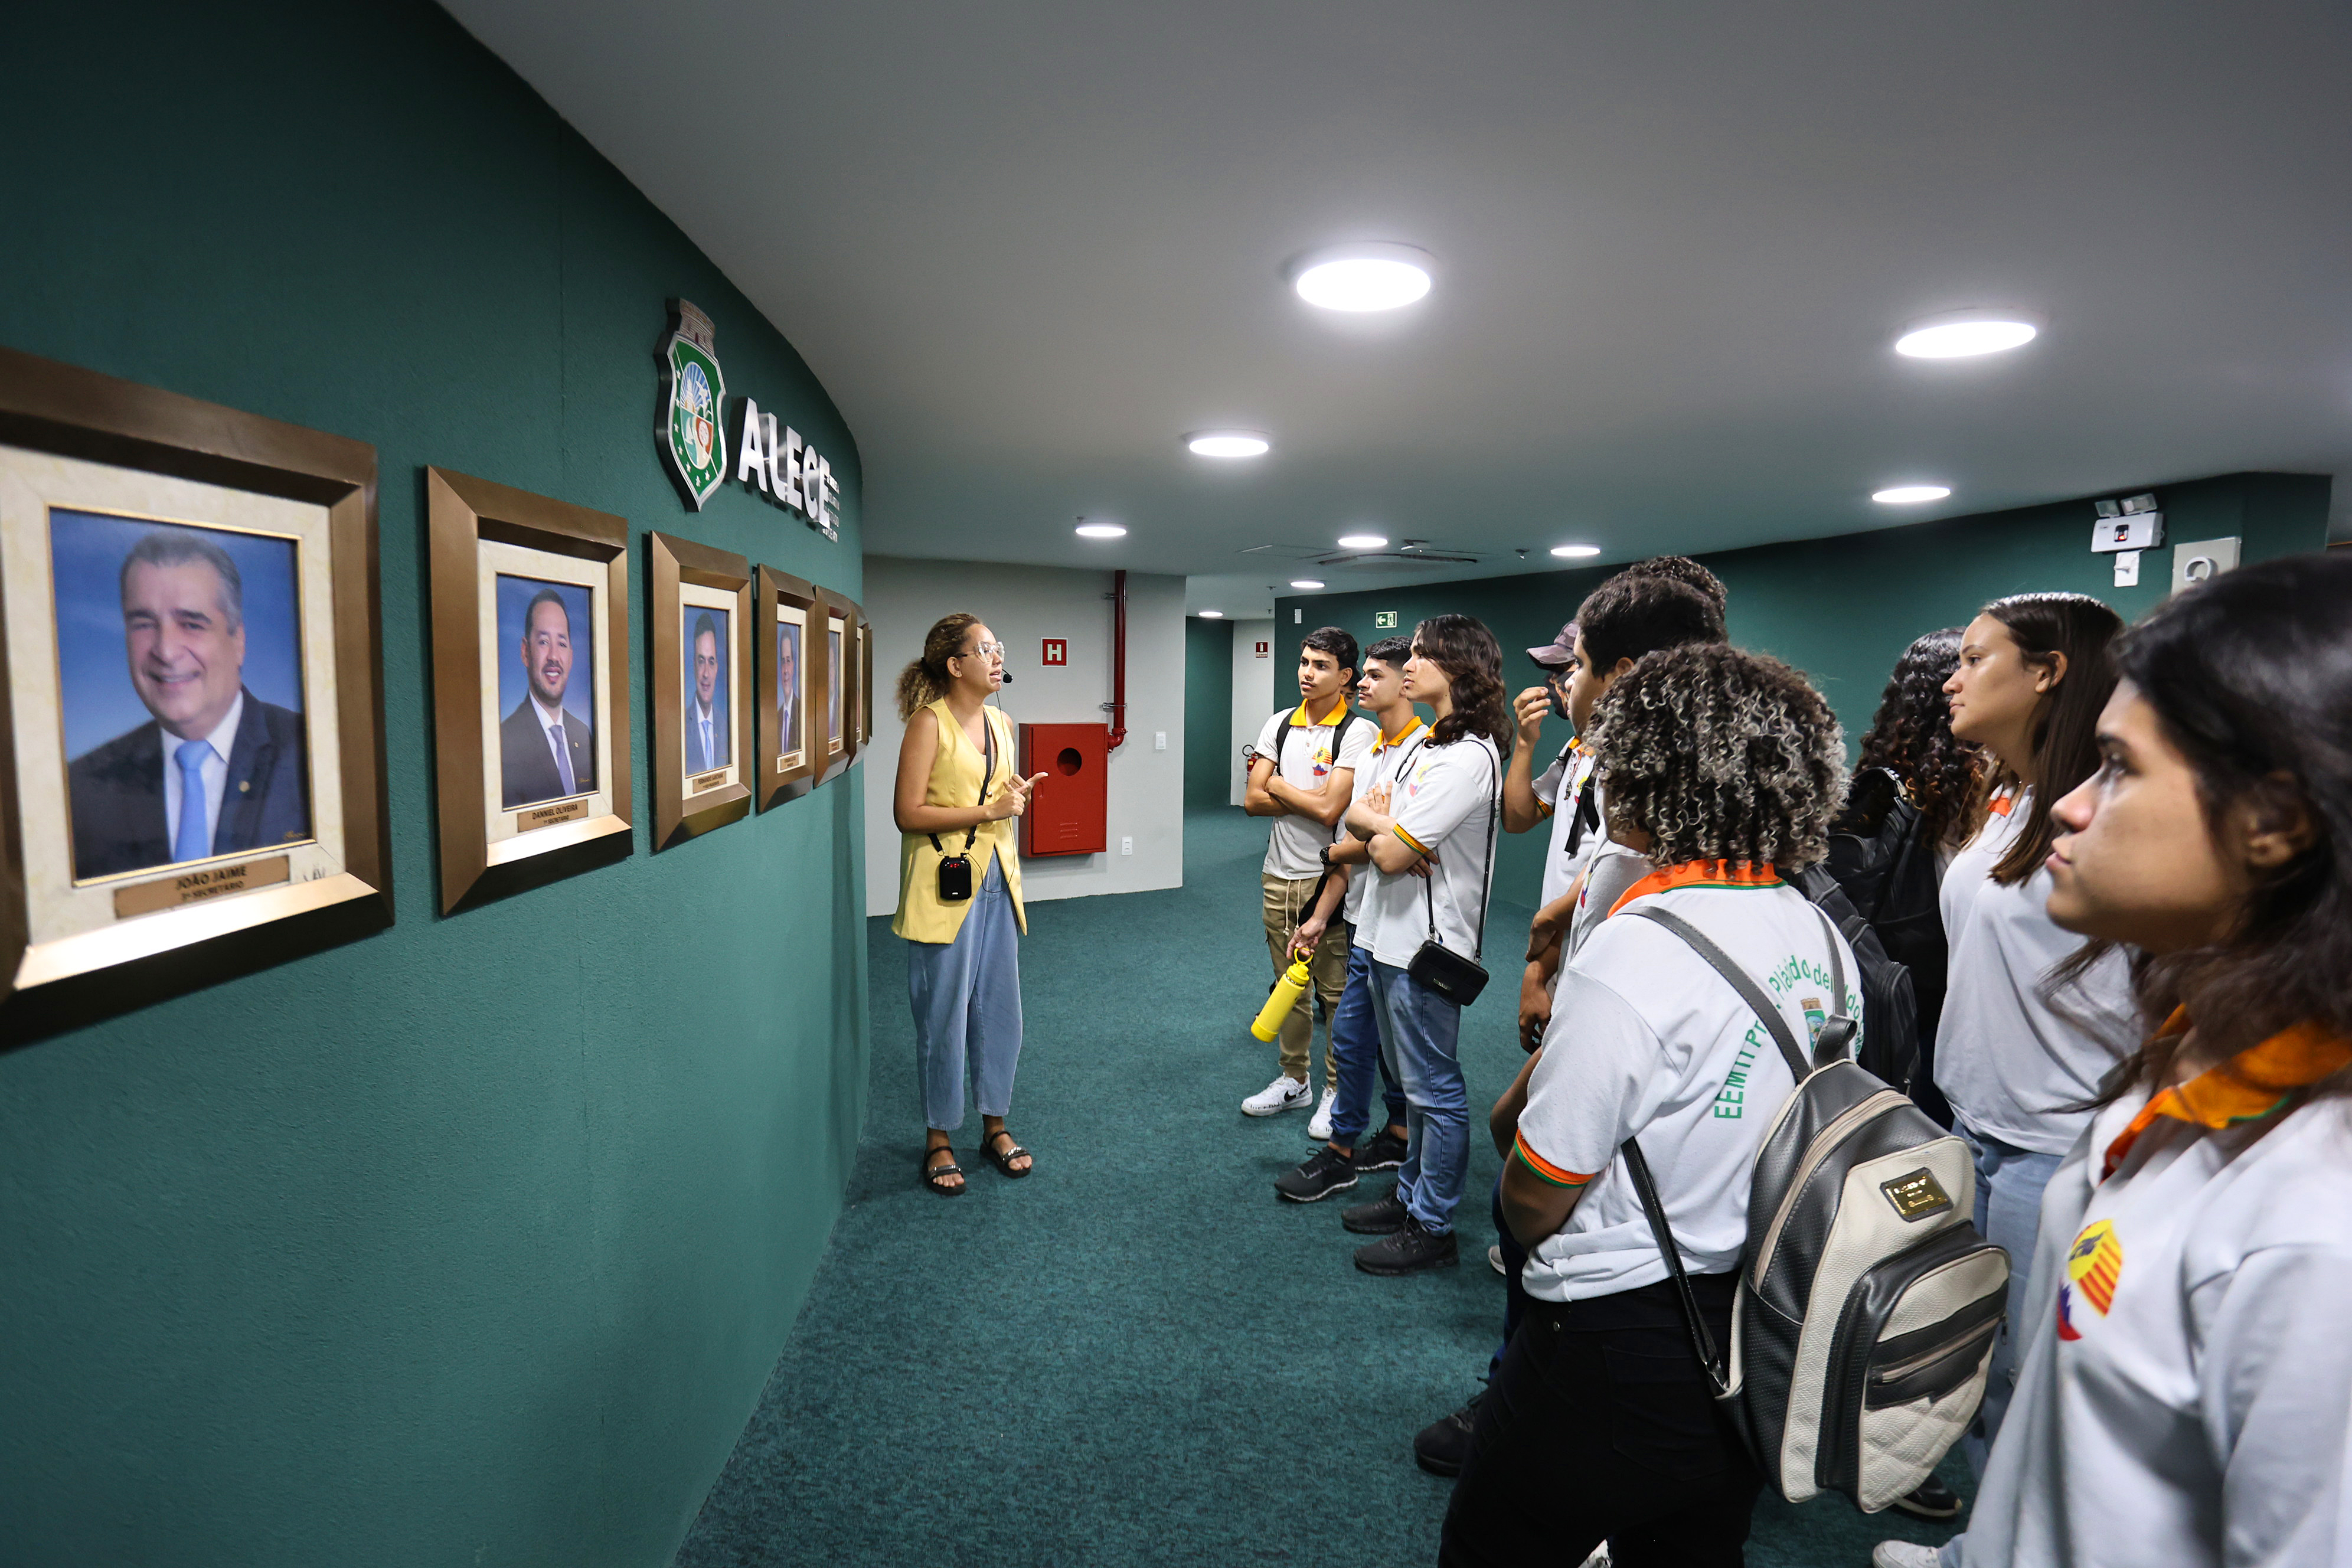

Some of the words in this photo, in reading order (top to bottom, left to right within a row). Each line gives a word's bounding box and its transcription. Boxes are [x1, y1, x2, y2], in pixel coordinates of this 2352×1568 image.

[737, 397, 830, 528] ALECE
[1047, 644, 1061, 661] H
[556, 803, 578, 814] OLIVEIRA
[213, 865, 247, 883] JAIME
